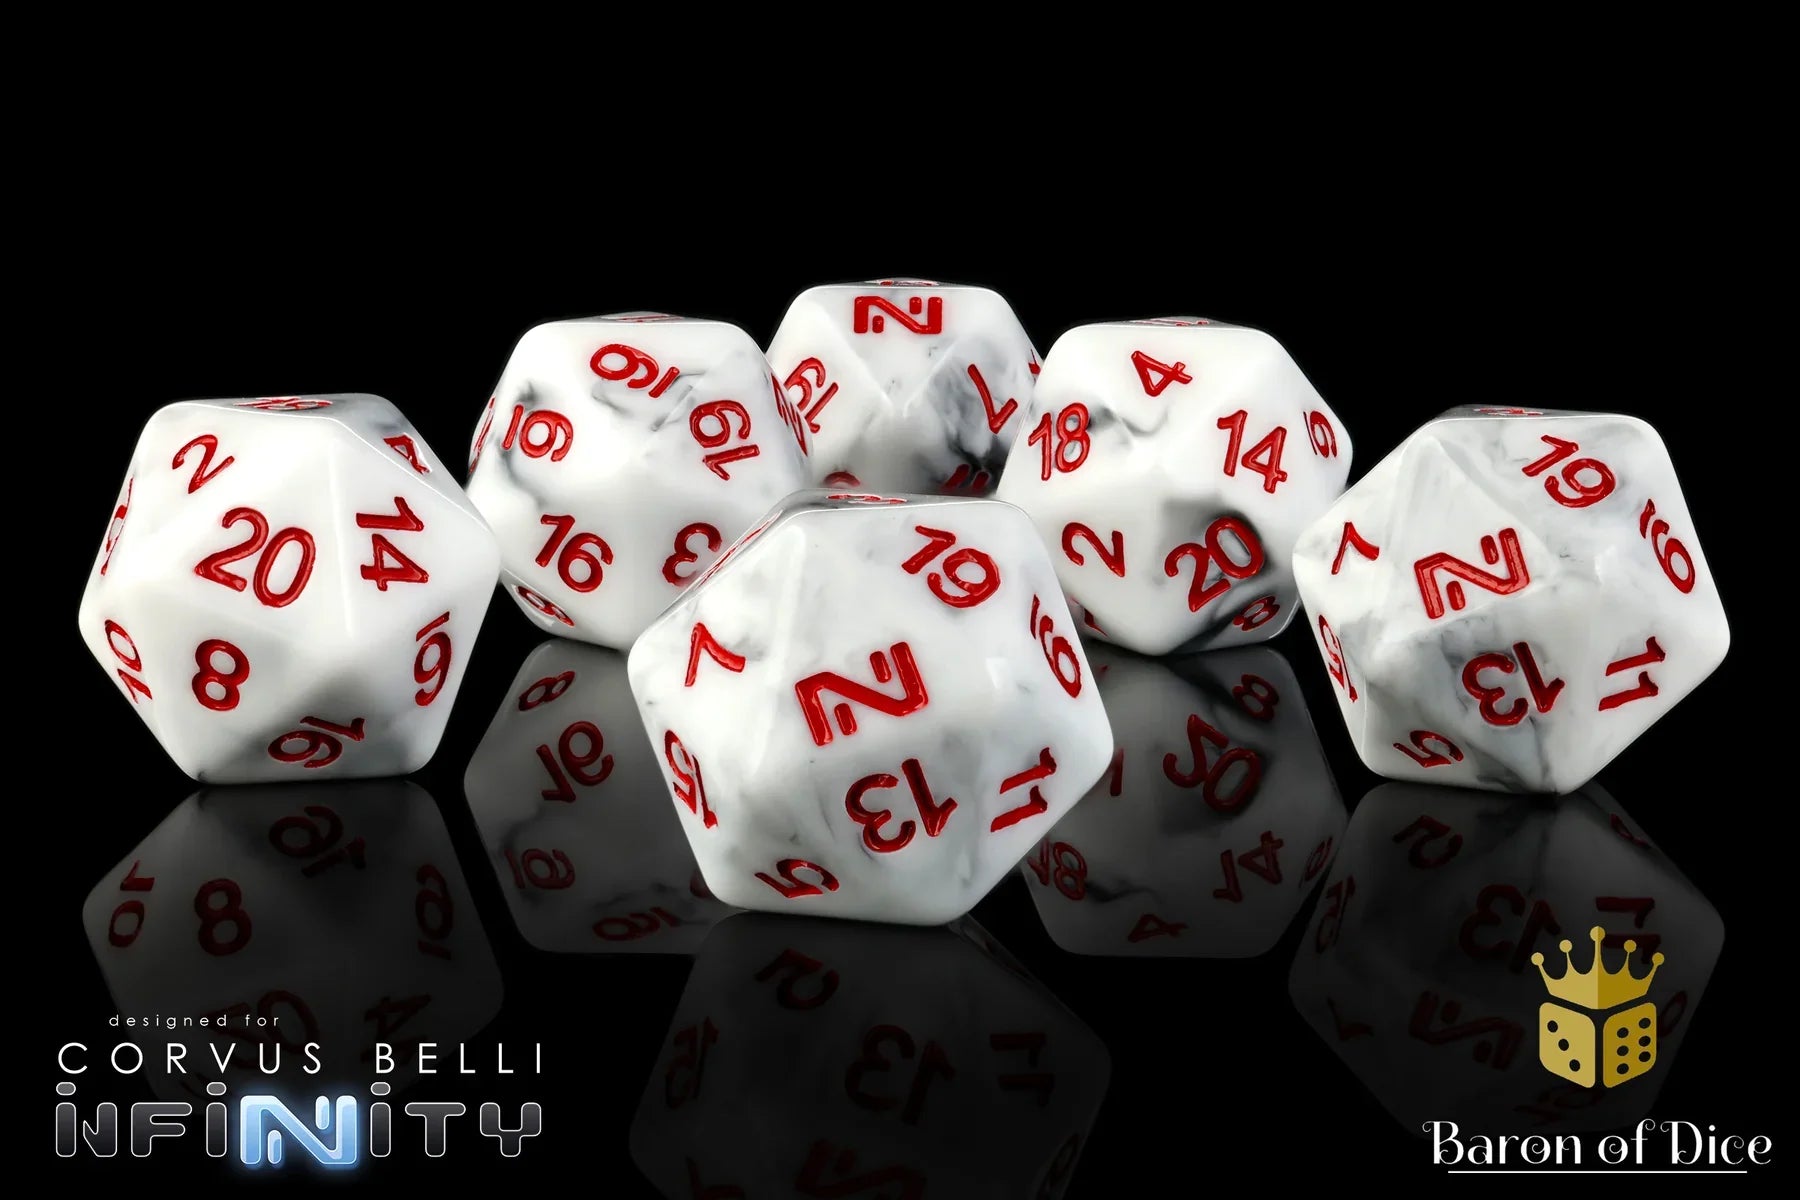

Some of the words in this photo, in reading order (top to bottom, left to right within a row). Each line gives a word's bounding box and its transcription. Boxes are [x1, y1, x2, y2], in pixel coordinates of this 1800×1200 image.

[1131, 350, 1193, 397] 4
[172, 434, 236, 495] 2
[689, 399, 760, 481] 19
[1027, 402, 1091, 482] 18
[1216, 409, 1288, 495] 14
[1521, 434, 1617, 508] 19
[193, 506, 317, 609] 20
[355, 496, 430, 592] 14
[535, 514, 614, 593] 16
[662, 522, 723, 587] 3
[901, 524, 1001, 609] 19
[1061, 521, 1126, 578] 2
[1164, 516, 1264, 613] 20
[1331, 521, 1380, 575] 7
[104, 619, 153, 704] 10
[191, 639, 251, 712] 8
[684, 621, 747, 688] 7
[1461, 641, 1565, 727] 13
[1598, 635, 1666, 712] 11
[844, 758, 958, 854] 13
[989, 747, 1057, 833] 11
